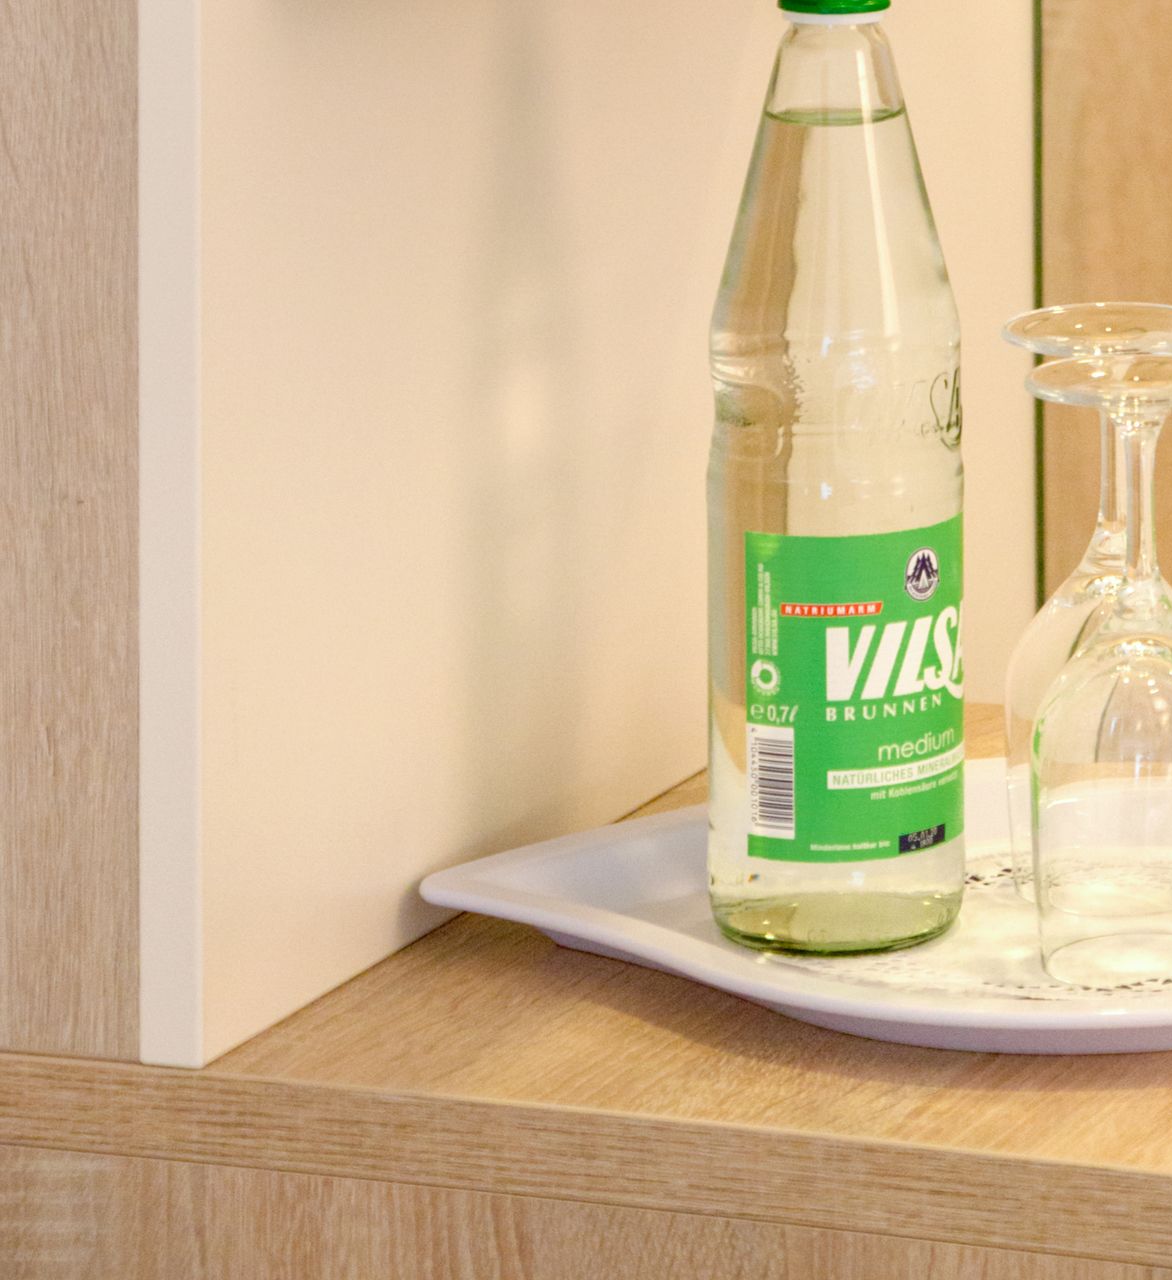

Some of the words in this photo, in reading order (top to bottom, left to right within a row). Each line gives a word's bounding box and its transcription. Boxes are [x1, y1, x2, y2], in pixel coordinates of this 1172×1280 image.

[785, 604, 876, 616] NATRIUMARM
[826, 693, 942, 722] BRUNNEN
[878, 728, 955, 762] medium
[832, 767, 913, 786] NATÜRLICHES
[871, 789, 886, 801] mit
